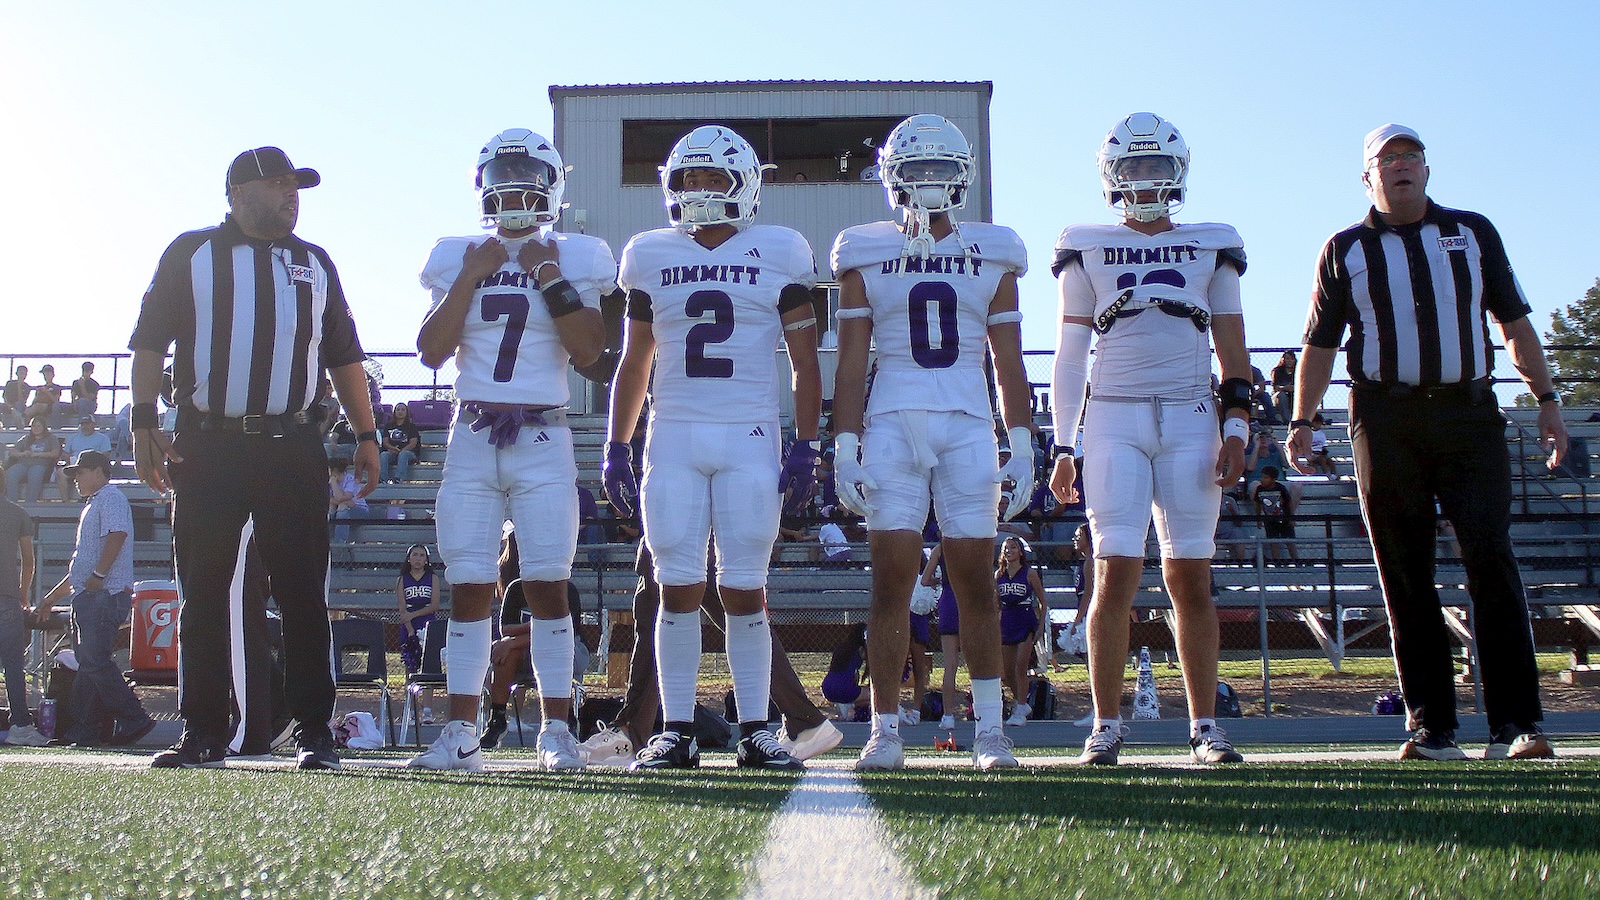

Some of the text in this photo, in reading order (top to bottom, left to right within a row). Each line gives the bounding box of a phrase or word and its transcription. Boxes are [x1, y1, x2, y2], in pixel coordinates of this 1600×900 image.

[497, 146, 526, 154] Riddell
[1130, 143, 1158, 151] Riddell
[682, 155, 711, 163] Riddell
[1103, 245, 1199, 266] DIMMITT
[660, 265, 761, 288] DIMMITT
[684, 289, 735, 379] 2
[908, 281, 960, 369] 0
[480, 293, 531, 383] 7
[404, 585, 432, 600] DHS
[997, 583, 1027, 597] DHS
[149, 602, 171, 627] G
